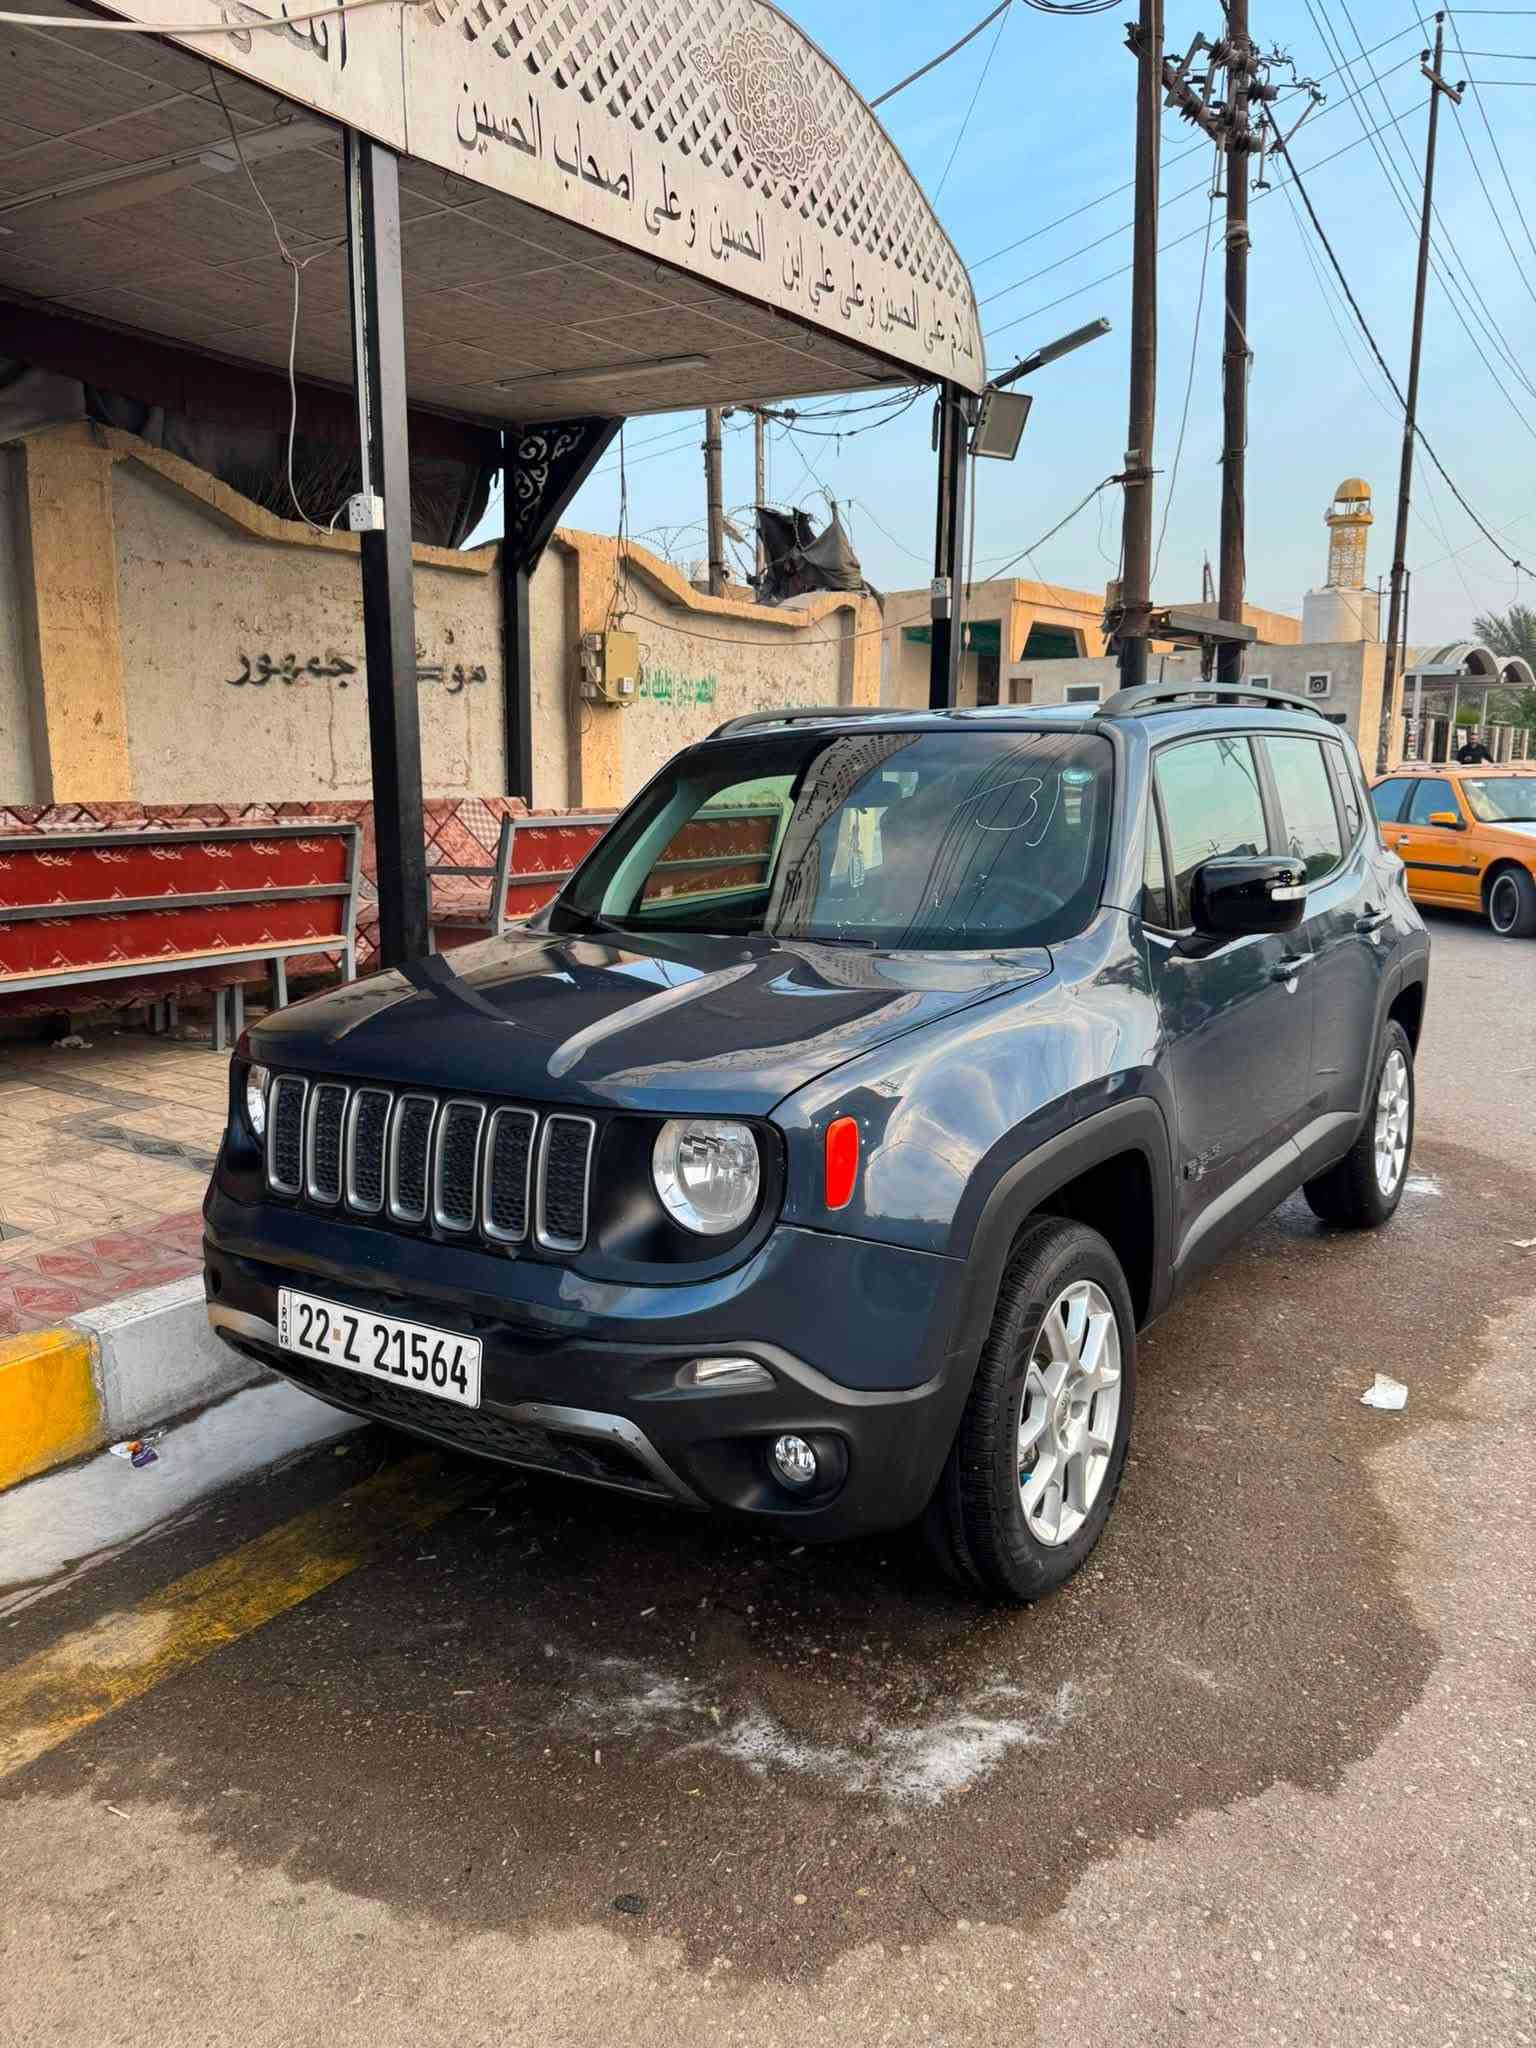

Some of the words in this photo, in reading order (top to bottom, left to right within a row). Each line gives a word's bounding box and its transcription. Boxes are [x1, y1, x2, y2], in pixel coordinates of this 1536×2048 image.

[456, 82, 543, 160] الحسين
[709, 202, 766, 264] الحسين
[879, 287, 919, 333] الحسين
[299, 1303, 330, 1354] 22
[343, 1315, 361, 1364] Z
[373, 1324, 468, 1395] 21564
